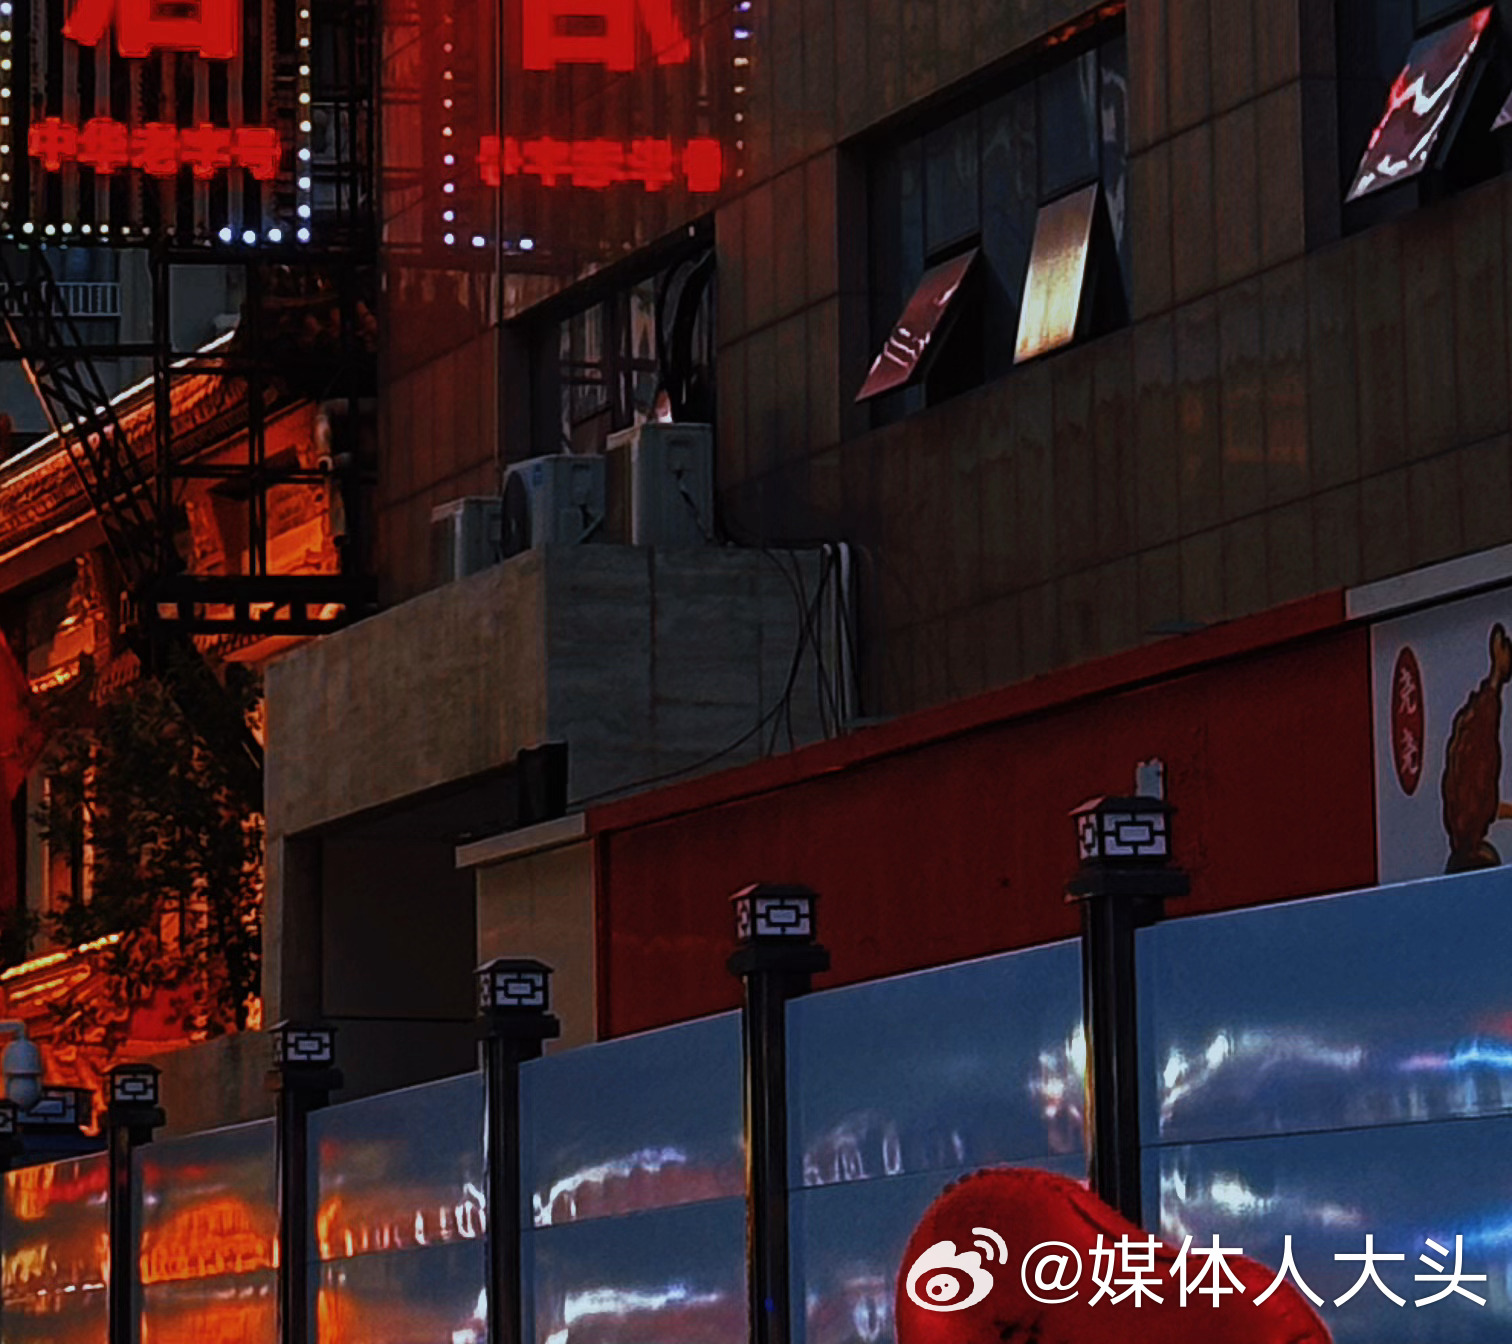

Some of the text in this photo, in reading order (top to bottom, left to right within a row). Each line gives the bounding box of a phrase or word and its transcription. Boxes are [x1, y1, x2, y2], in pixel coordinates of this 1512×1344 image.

[27, 117, 284, 181] 中华老字号
